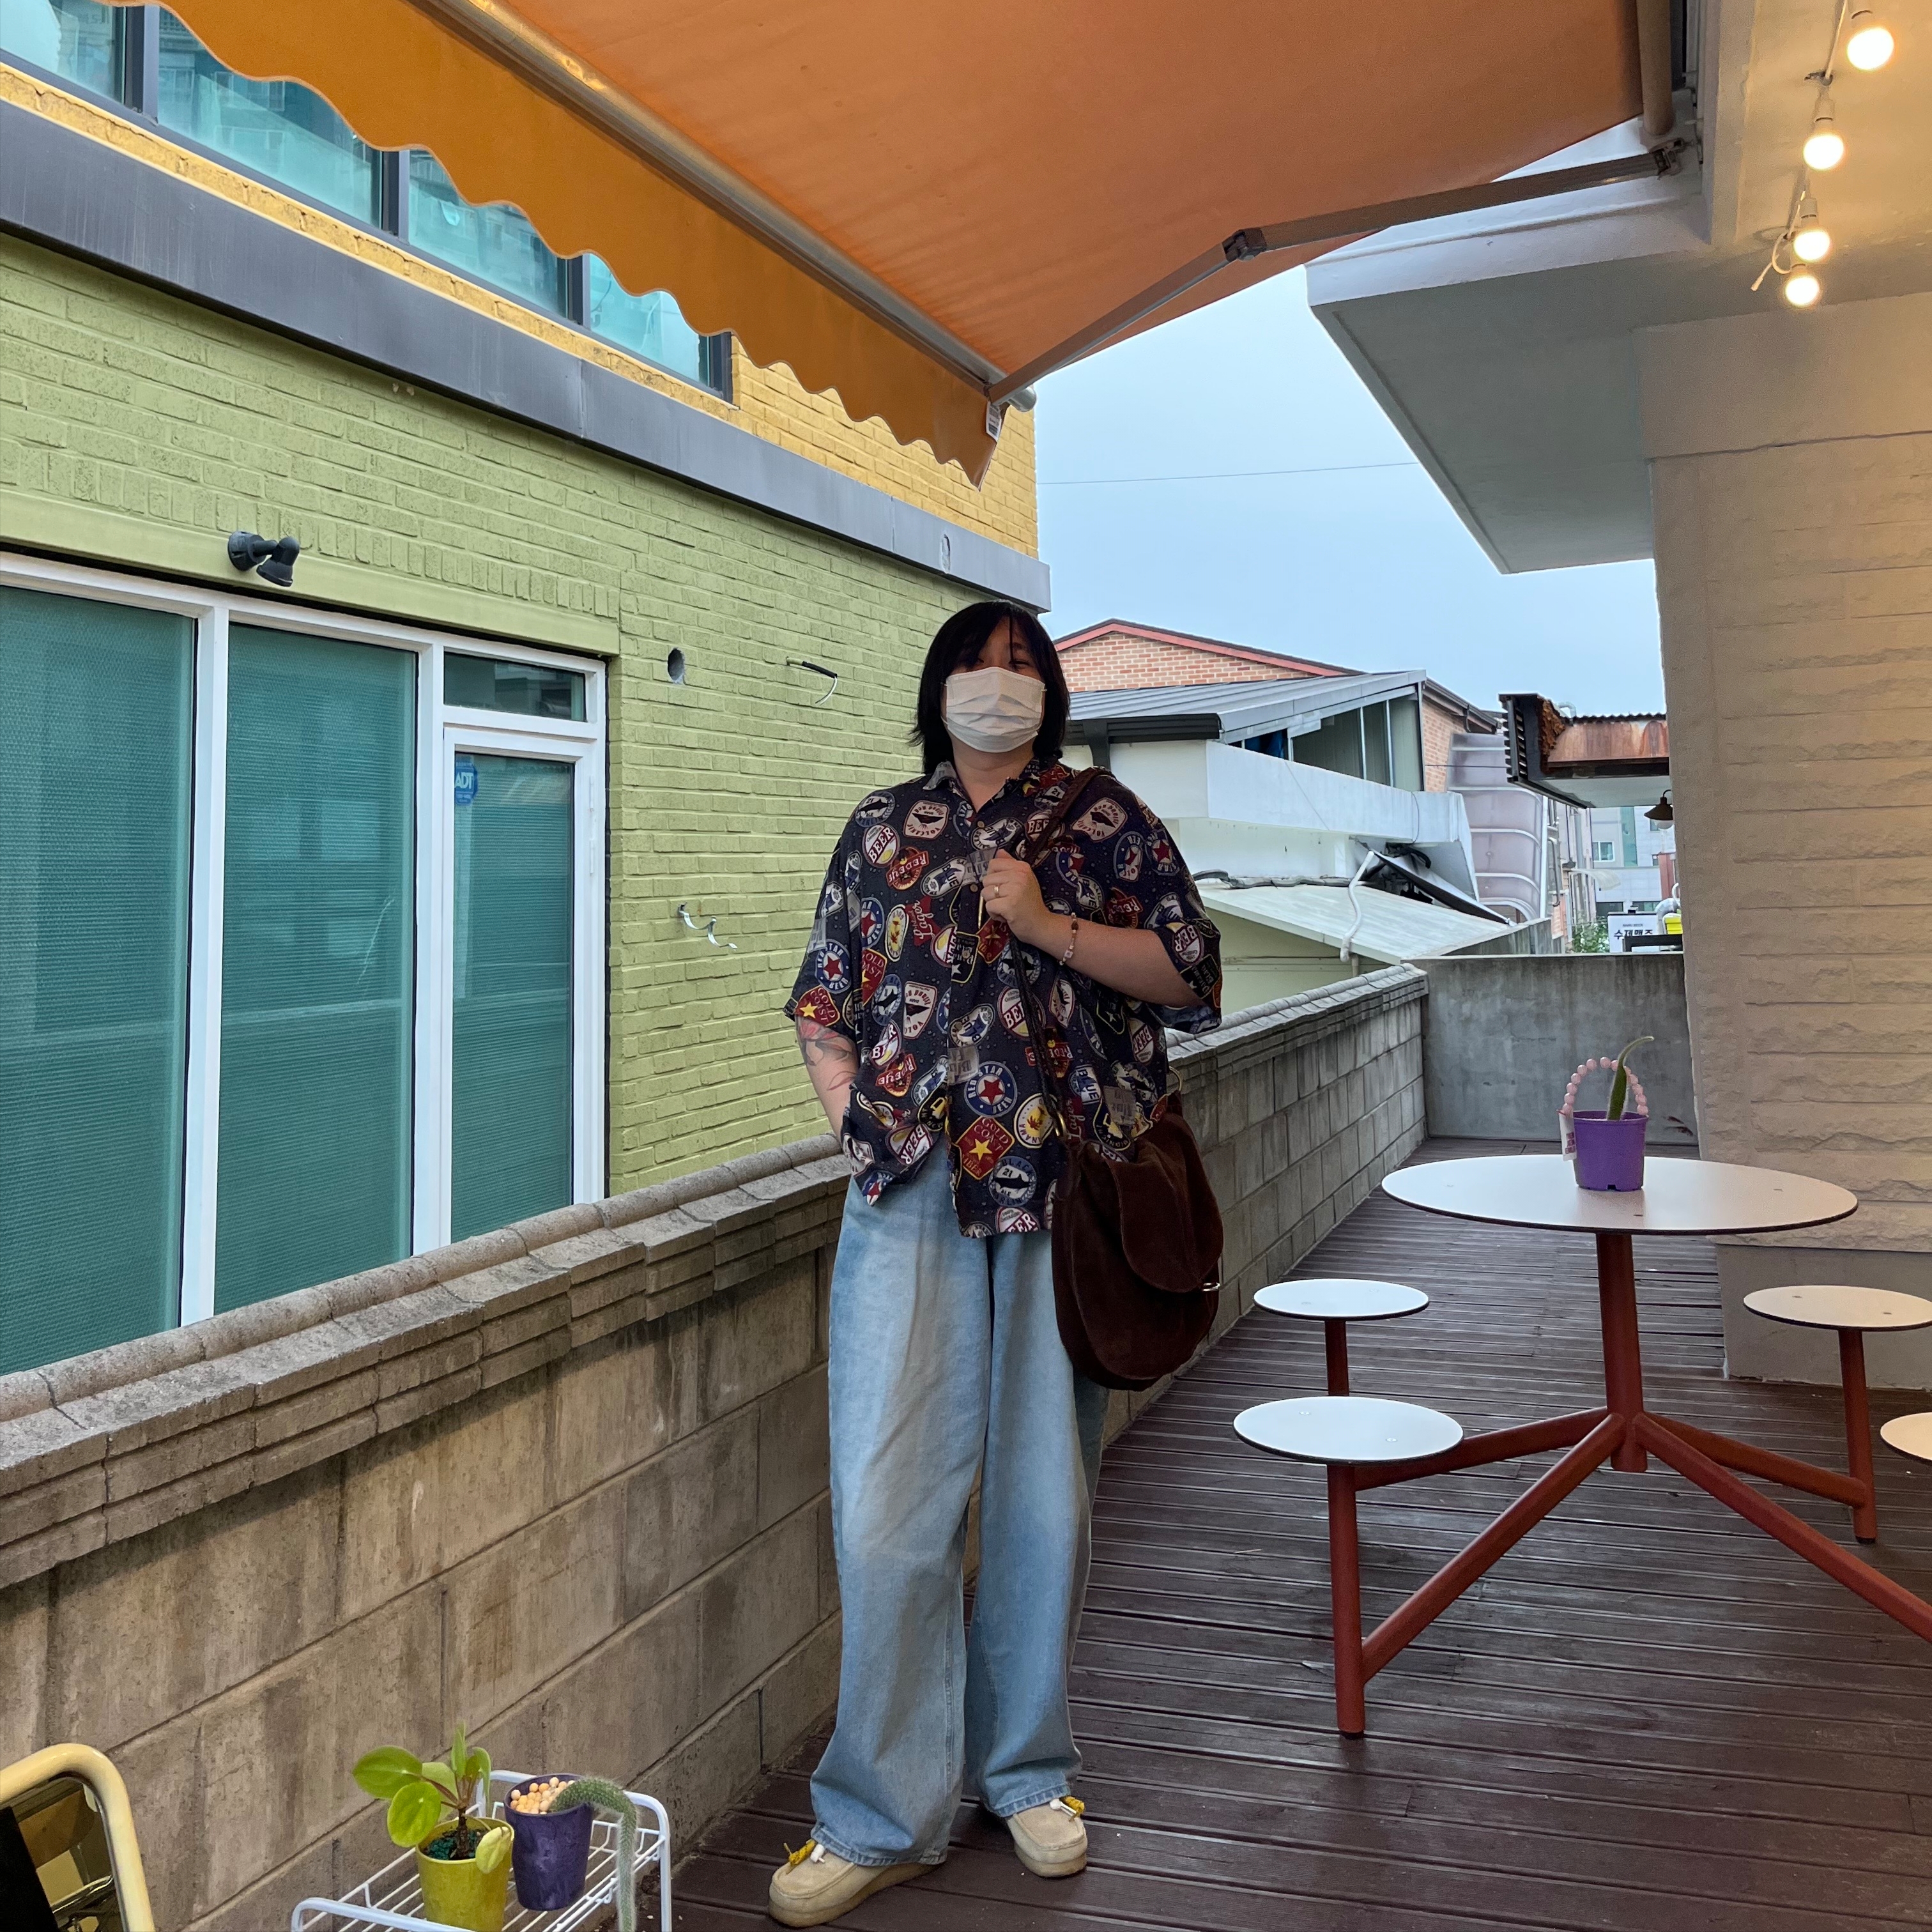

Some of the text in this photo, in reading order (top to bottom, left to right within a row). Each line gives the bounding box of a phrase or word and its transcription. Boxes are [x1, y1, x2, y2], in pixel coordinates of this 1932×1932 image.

[454, 772, 473, 789] ADT
[868, 827, 894, 864] BEER
[888, 854, 926, 884] REDEYE
[913, 900, 935, 940] Lager
[825, 943, 844, 957] TAR
[829, 977, 848, 990] BEER
[809, 990, 829, 1022] COAST
[817, 987, 836, 1019] GOLD
[967, 1065, 1003, 1099] RED STAR
[900, 1124, 926, 1165] BEER
[974, 1124, 1004, 1151] COAST
[981, 1117, 1009, 1144] GOLD
[1002, 1167, 1013, 1178] 21
